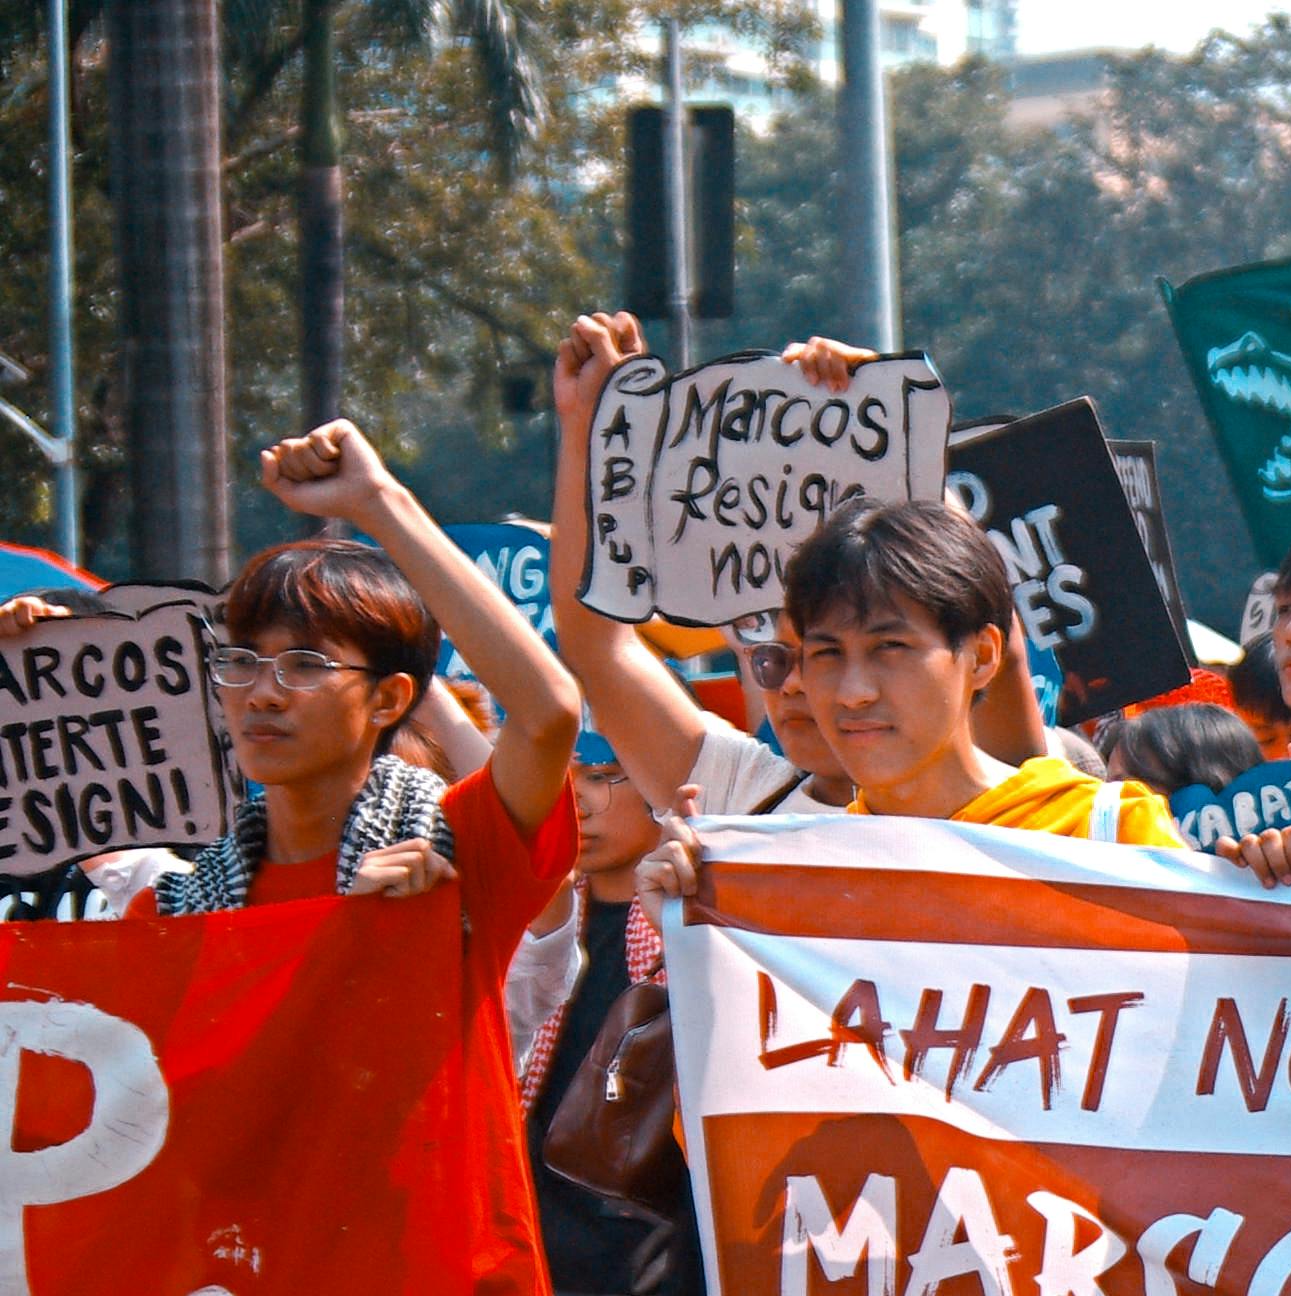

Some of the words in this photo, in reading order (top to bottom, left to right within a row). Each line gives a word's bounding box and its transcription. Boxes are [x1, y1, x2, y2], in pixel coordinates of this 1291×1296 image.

[669, 377, 888, 461] Marcos
[0, 705, 167, 790] TERTE
[757, 969, 1145, 1112] LAHAT
